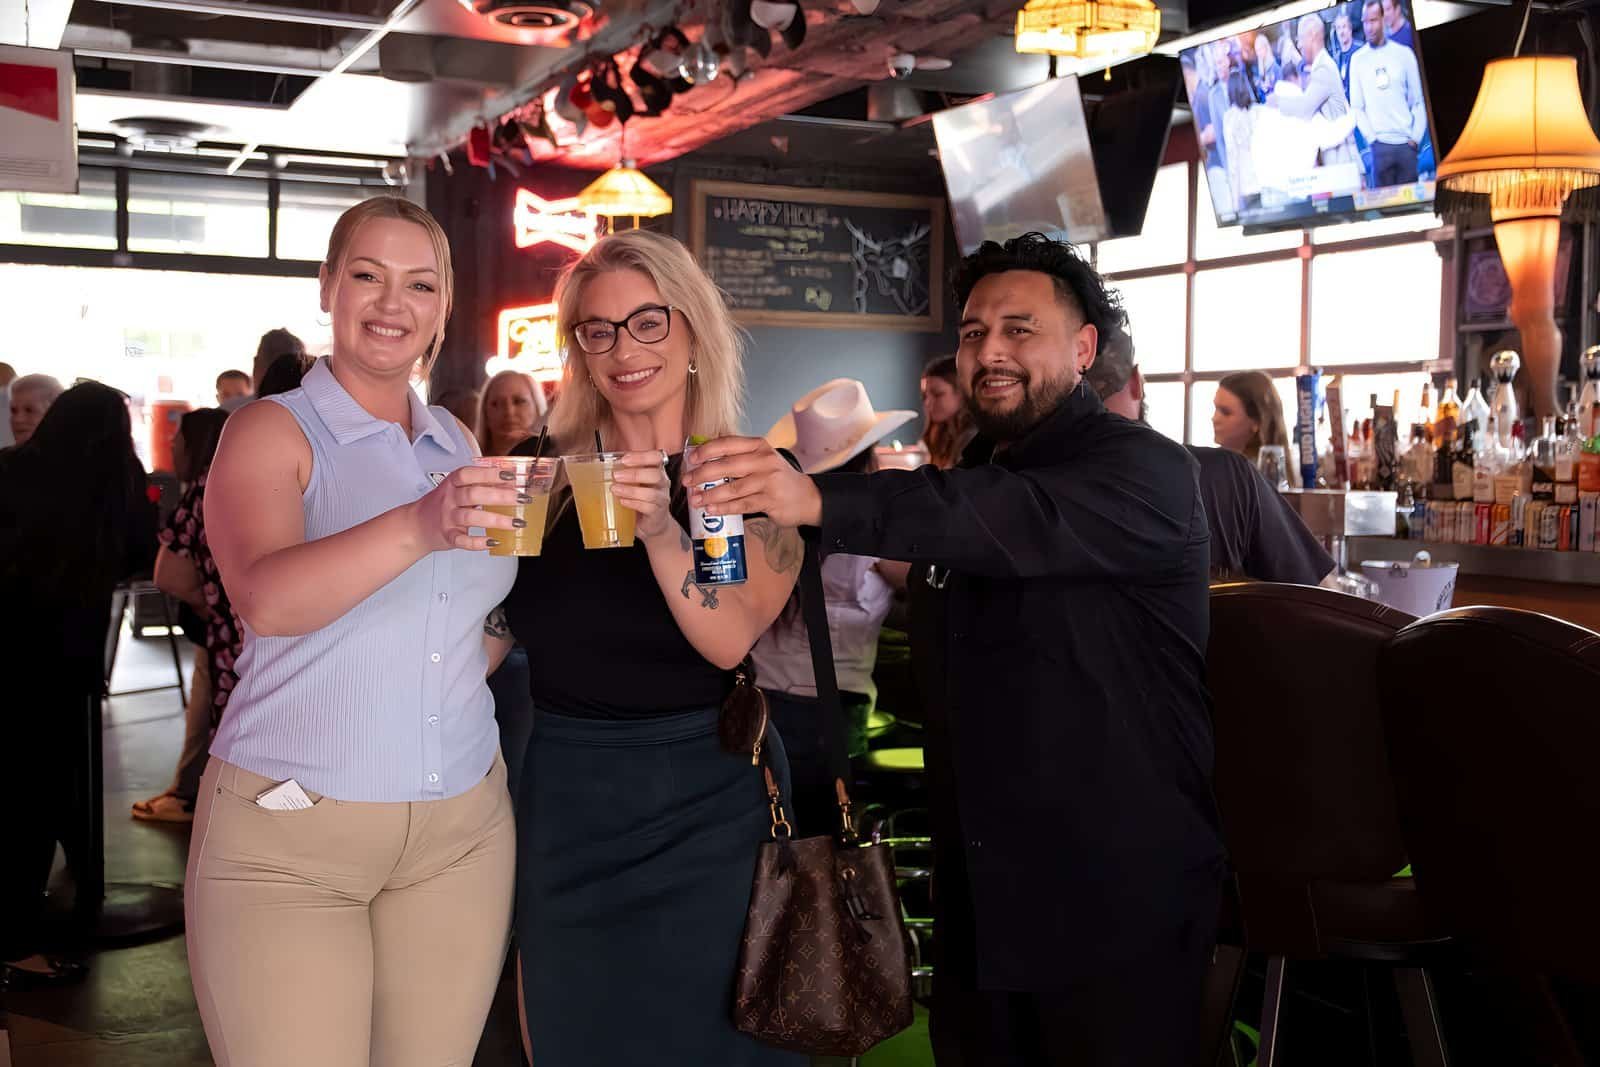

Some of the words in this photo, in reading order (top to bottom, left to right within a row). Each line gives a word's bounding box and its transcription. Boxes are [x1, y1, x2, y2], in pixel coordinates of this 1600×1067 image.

[722, 199, 782, 224] HAPPY
[1300, 391, 1313, 433] LIGHT
[1301, 434, 1314, 465] BUD
